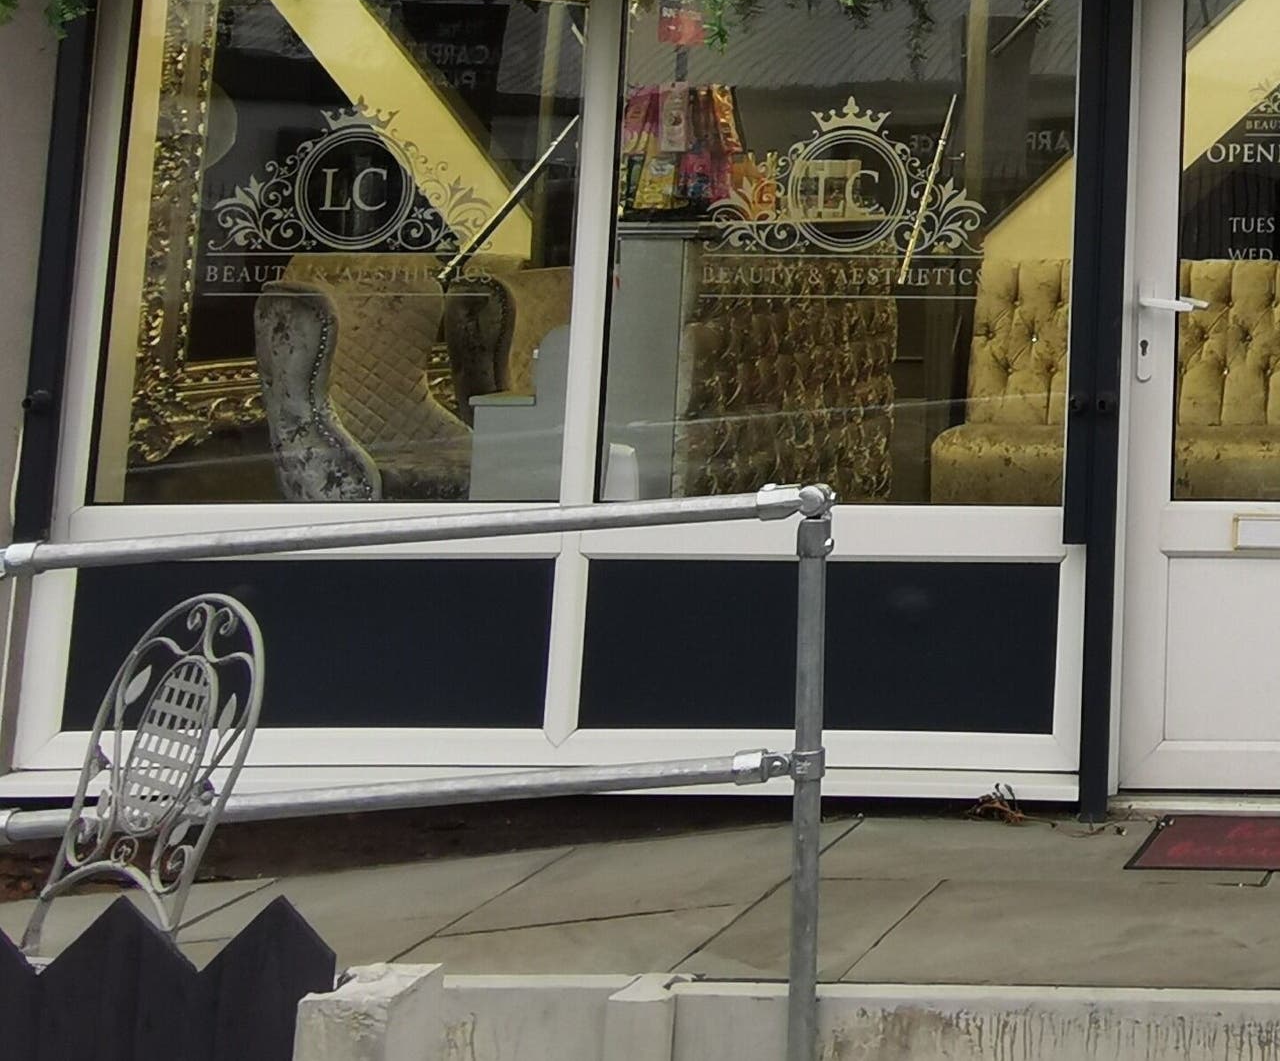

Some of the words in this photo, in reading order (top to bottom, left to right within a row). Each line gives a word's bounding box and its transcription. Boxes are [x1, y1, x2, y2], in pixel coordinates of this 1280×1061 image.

[319, 167, 388, 212] LC
[816, 169, 885, 214] LC
[1229, 217, 1276, 234] TUES
[1228, 247, 1274, 261] WED
[702, 267, 795, 285] BEAUTY
[808, 267, 824, 285] &
